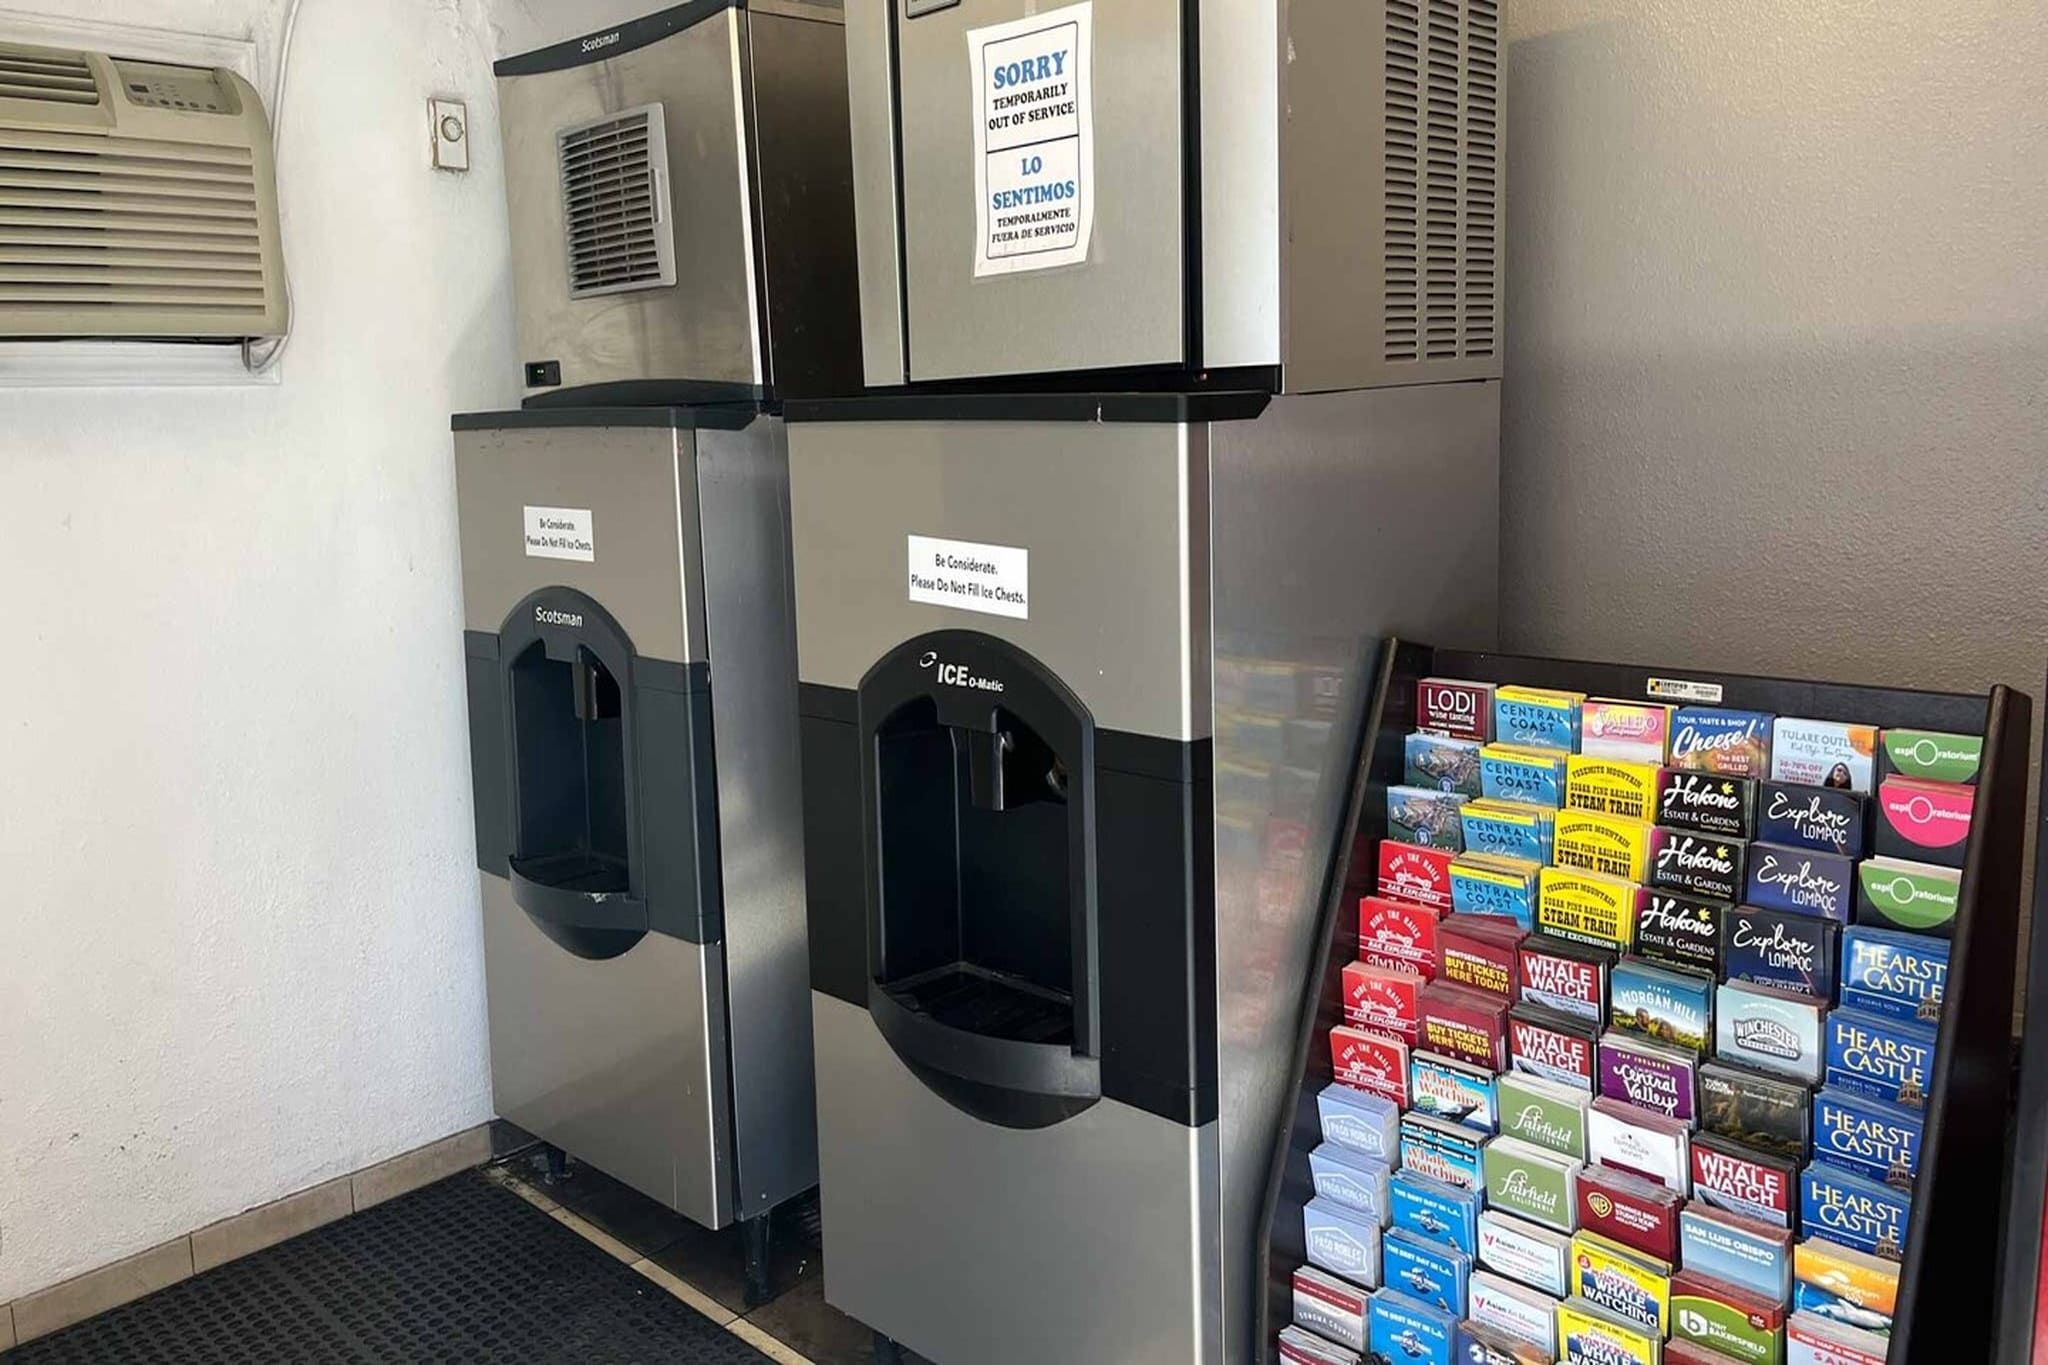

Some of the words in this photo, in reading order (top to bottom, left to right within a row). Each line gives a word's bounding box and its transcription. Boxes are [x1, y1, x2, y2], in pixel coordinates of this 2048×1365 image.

[581, 32, 620, 53] Scotsman
[993, 50, 1068, 90] SORRY
[992, 82, 1069, 111] TEMPORARILY
[988, 114, 1009, 131] OUT
[1012, 111, 1026, 127] OF
[1028, 101, 1075, 123] SERVICE
[1021, 156, 1042, 176] LO
[992, 180, 1075, 210] SENTIMOS
[997, 207, 1071, 228] TEMPORALMENTE
[991, 230, 1019, 243] FUERA
[1021, 228, 1033, 239] DE
[1034, 222, 1075, 238] SERVICIO
[935, 553, 946, 568] Be
[947, 555, 998, 575] Considerate.
[911, 574, 935, 590] Please
[937, 578, 949, 591] Do
[950, 580, 966, 595] Not
[967, 583, 980, 596] Fill
[981, 585, 993, 599] Ice
[995, 587, 1026, 604] Chests.
[535, 606, 583, 627] Scotsman
[937, 663, 968, 686] ICE
[1428, 688, 1476, 714] LODI
[1501, 703, 1563, 722] CENTRAL
[1509, 717, 1556, 733] COAST
[1699, 717, 1719, 726] TASTE
[1727, 719, 1747, 727] SHOP
[1672, 719, 1757, 759] Cheese!
[1781, 730, 1819, 744] TULARE
[1485, 761, 1549, 781] CENTRAL
[1717, 762, 1749, 772] GRILLED
[1732, 755, 1750, 764] BEST
[1496, 775, 1541, 792] COAST
[1664, 775, 1739, 809] Hakone
[1570, 792, 1606, 812] STEAM
[1609, 798, 1643, 818] TRAIN
[1664, 808, 1689, 821] ESTATE
[1691, 811, 1698, 822] &
[1701, 812, 1740, 828] GARDENS
[1768, 792, 1850, 830] Explore
[1467, 819, 1530, 838] CENTRAL
[1478, 832, 1523, 848] COAST
[1803, 823, 1847, 844] LOMPOC
[1558, 849, 1594, 870] STEAM
[1597, 857, 1631, 878] TRAIN
[1659, 836, 1733, 874] Hakone
[1657, 869, 1683, 884] ESTATE
[1685, 873, 1692, 884] &
[1694, 877, 1732, 894] GARDENS
[1757, 855, 1840, 893] Explore
[1456, 879, 1518, 898] CENTRAL
[1466, 892, 1512, 910] COAST
[1792, 889, 1836, 911] LOMPOC
[1544, 907, 1580, 928] STEAM
[1583, 916, 1617, 937] TRAIN
[1641, 897, 1715, 937] Hakone
[1543, 925, 1567, 938] DAILY
[1567, 931, 1617, 949] EXCURSIONS
[1640, 930, 1665, 946] ESTATE
[1667, 936, 1674, 947] &
[1677, 939, 1715, 956] GARDENS
[1733, 920, 1815, 957] Explore
[1445, 956, 1466, 970] BUY
[1467, 962, 1508, 982] TICKETS
[1525, 956, 1592, 987] WHALE
[1768, 951, 1813, 972] LOMPOC
[1857, 944, 1947, 982] HEARST
[1446, 967, 1472, 983] HERE
[1474, 975, 1509, 994] TODAY!
[1530, 974, 1588, 1001] WATCH
[1864, 968, 1944, 1001] CASTLE
[1621, 991, 1671, 1009] MORGAN
[1674, 1001, 1696, 1020] HILL
[1426, 1022, 1446, 1035] BUY
[1448, 1028, 1488, 1047] TICKETS
[1427, 1033, 1454, 1048] HERE
[1456, 1040, 1491, 1059] TODAY!
[1515, 1025, 1584, 1060] WHALE
[1735, 1019, 1799, 1050] WINCHESTER
[1836, 1024, 1926, 1066] HEARST
[1521, 1043, 1580, 1073] WATCH
[1843, 1048, 1923, 1087] CASTLE
[1419, 1071, 1460, 1089] Whale
[1613, 1064, 1678, 1094] Central
[1624, 1079, 1679, 1117] Valley
[1512, 1104, 1572, 1145] fairfield
[1823, 1107, 1914, 1148] HEARST
[1526, 1130, 1569, 1149] CALIFORNIA
[1831, 1131, 1912, 1167] CASTLE
[1407, 1148, 1448, 1166] Whale
[1697, 1151, 1779, 1194] WHALE
[1393, 1187, 1406, 1198] THE
[1497, 1169, 1557, 1207] fairfield
[1704, 1172, 1775, 1208] WATCH
[1511, 1194, 1554, 1213] CALIFORNIA
[1812, 1181, 1902, 1224] HEARST
[1819, 1206, 1900, 1243] CASTLE
[1496, 1237, 1515, 1250] Asian
[1685, 1223, 1707, 1237] SAN
[1708, 1230, 1732, 1246] LUIS
[1733, 1240, 1775, 1261] OBISPO
[1487, 1300, 1506, 1313] Asian
[1583, 1284, 1658, 1327] WATCHING
[1595, 1277, 1646, 1310] WHALE
[1299, 1312, 1327, 1324] SONOMA
[1709, 1319, 1728, 1331] VISIT
[1708, 1326, 1767, 1355] BAKERSFIELD
